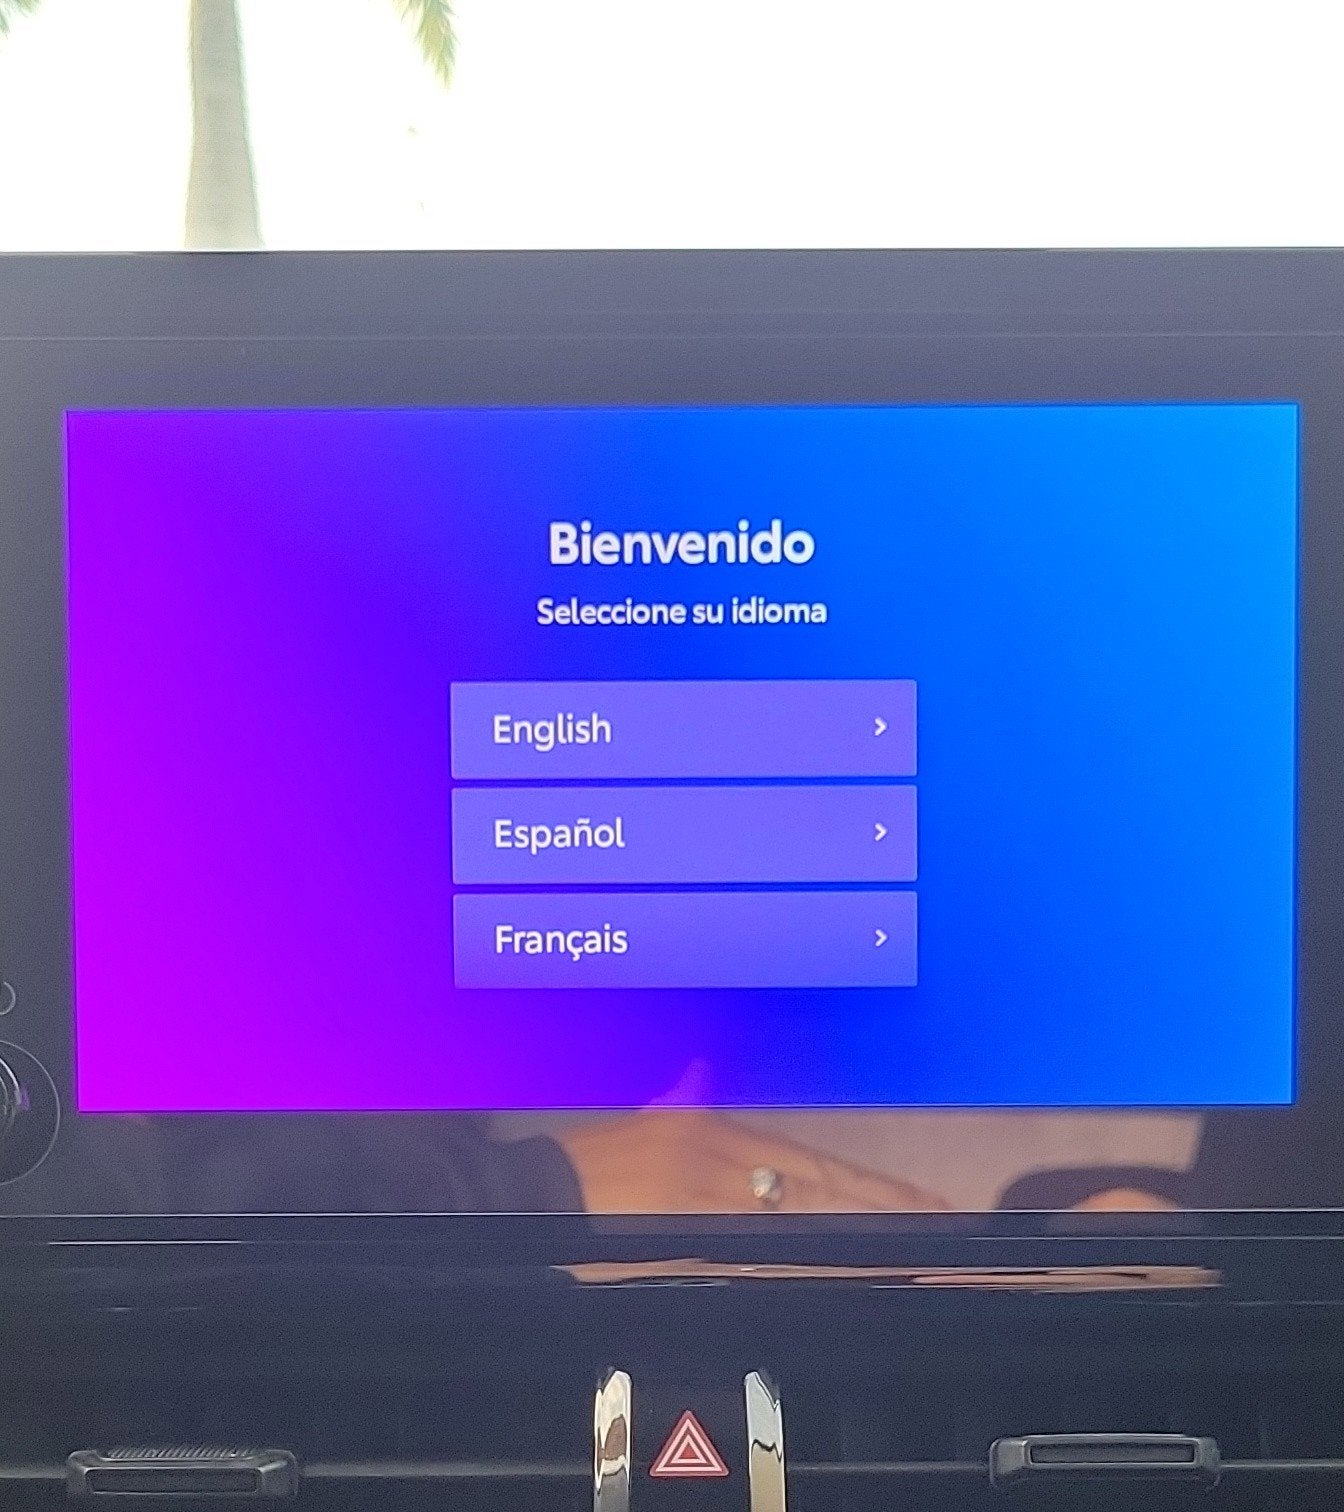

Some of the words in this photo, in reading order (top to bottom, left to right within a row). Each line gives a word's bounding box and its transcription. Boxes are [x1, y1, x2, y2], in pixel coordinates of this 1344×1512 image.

[549, 518, 816, 566] Bienvenido
[536, 597, 687, 626] Seleccione
[692, 601, 725, 625] su
[731, 597, 828, 625] idioma
[492, 712, 613, 752] English
[493, 816, 626, 855] Español
[494, 923, 629, 961] Français
